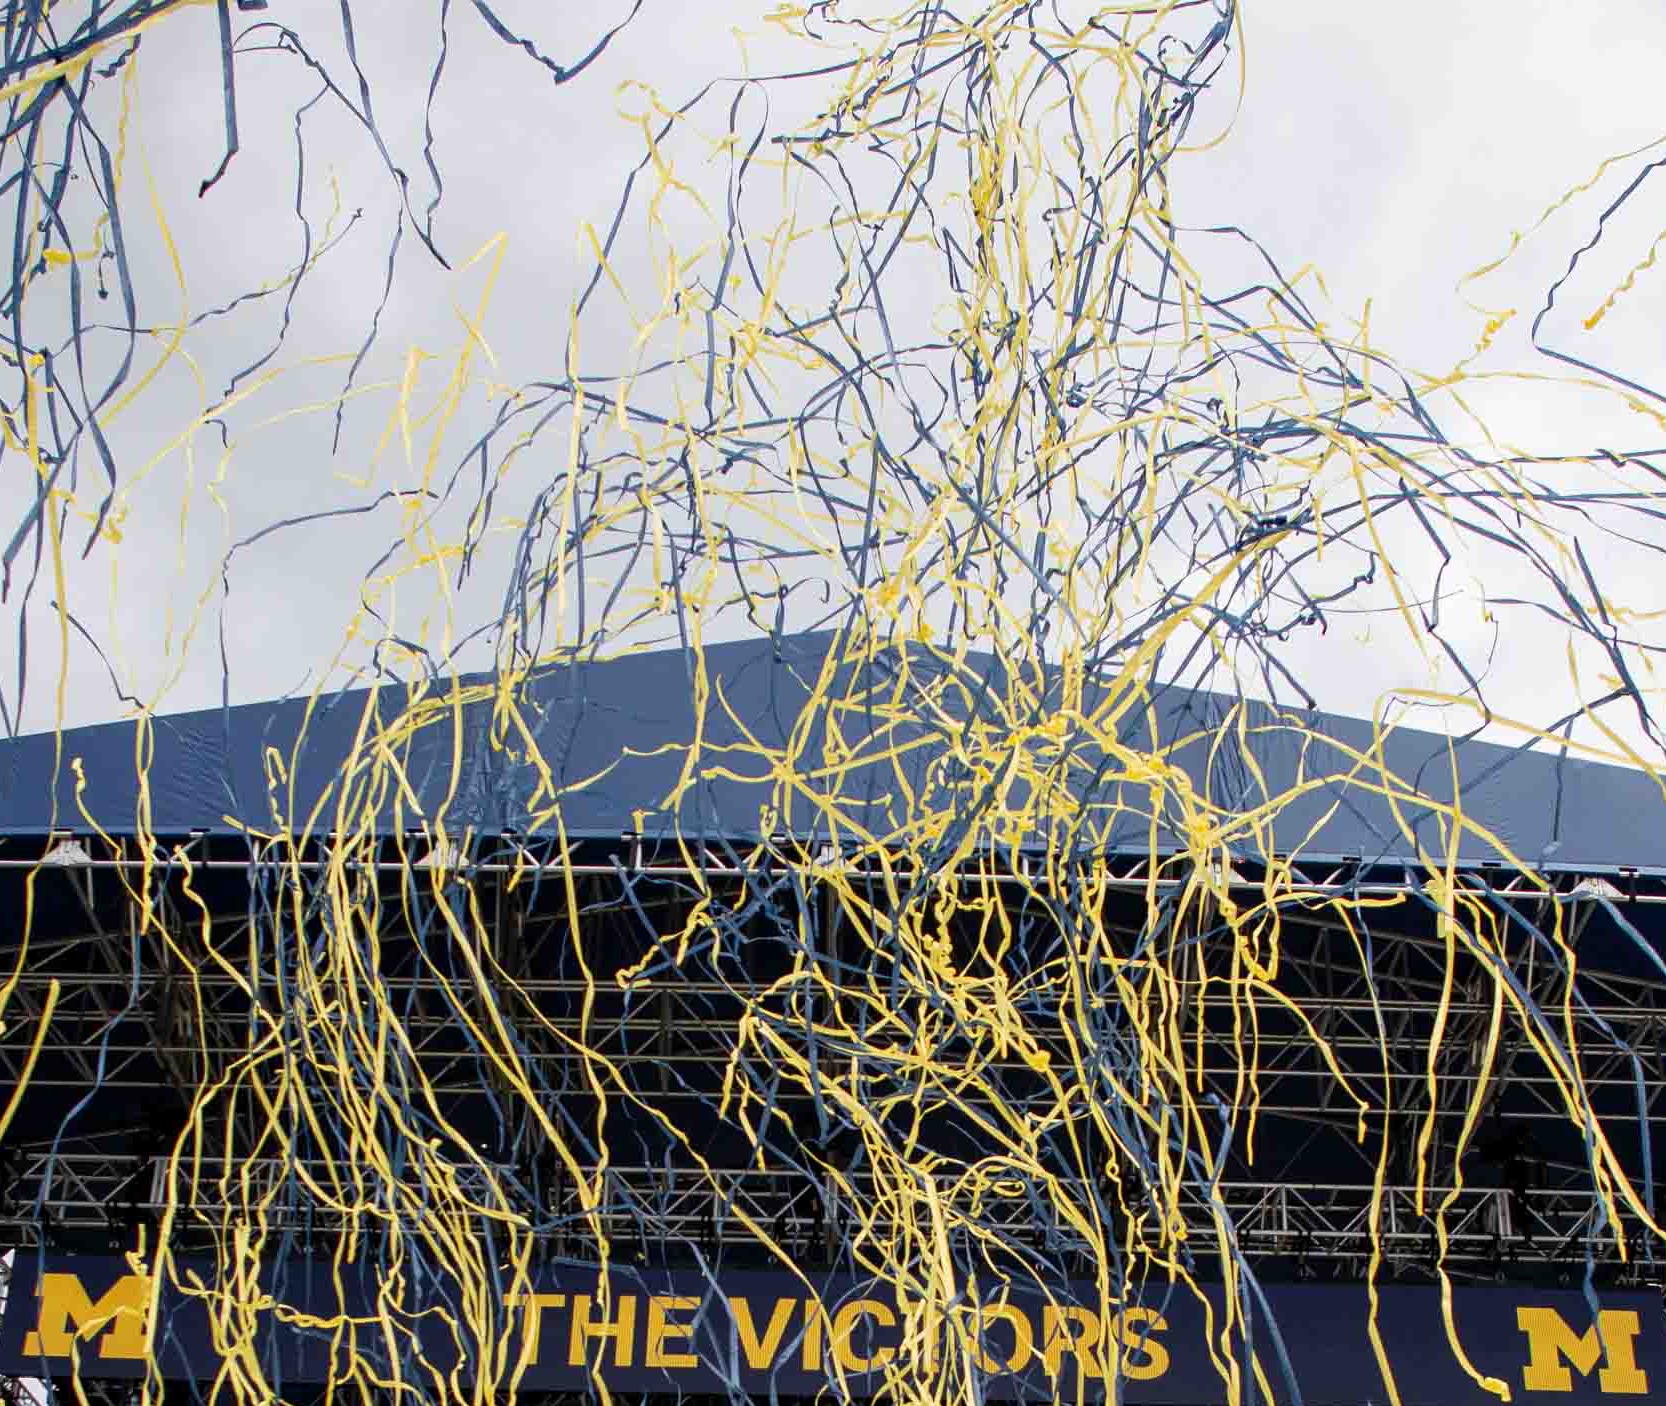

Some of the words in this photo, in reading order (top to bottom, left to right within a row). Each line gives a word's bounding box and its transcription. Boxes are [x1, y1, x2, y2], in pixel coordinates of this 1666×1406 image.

[22, 1274, 154, 1359] M
[503, 1295, 701, 1367] THE
[1517, 1307, 1648, 1394] M
